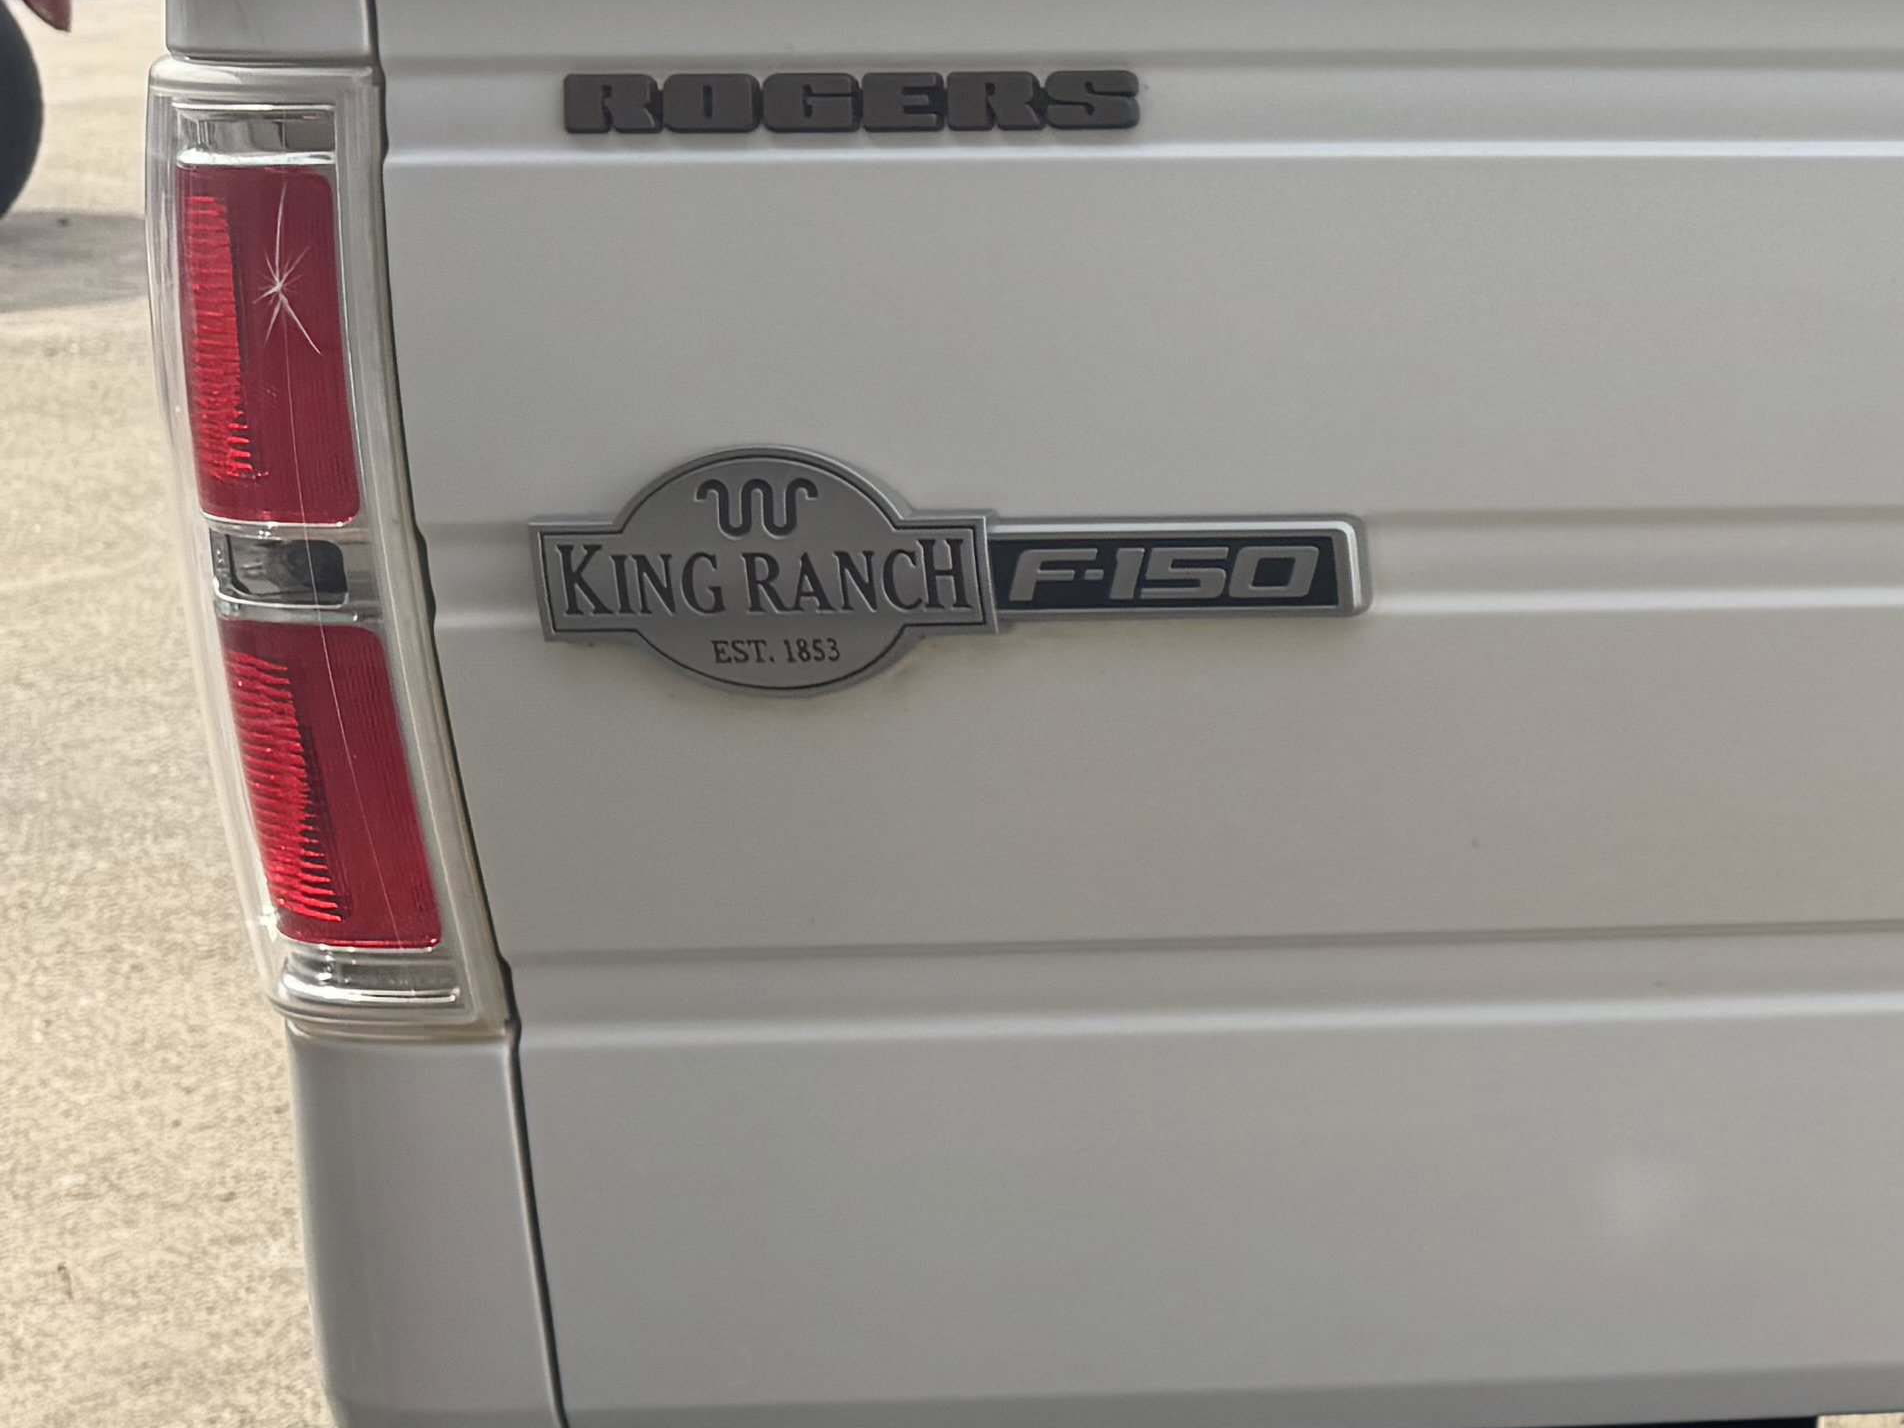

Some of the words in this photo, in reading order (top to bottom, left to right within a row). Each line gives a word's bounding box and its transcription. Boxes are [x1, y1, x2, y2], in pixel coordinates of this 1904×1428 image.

[563, 70, 1141, 134] ROGERS
[554, 544, 726, 616] KING
[740, 538, 975, 614] RANCH
[1008, 545, 1320, 602] F-150
[711, 640, 775, 664] EST.
[783, 638, 841, 664] 1853
